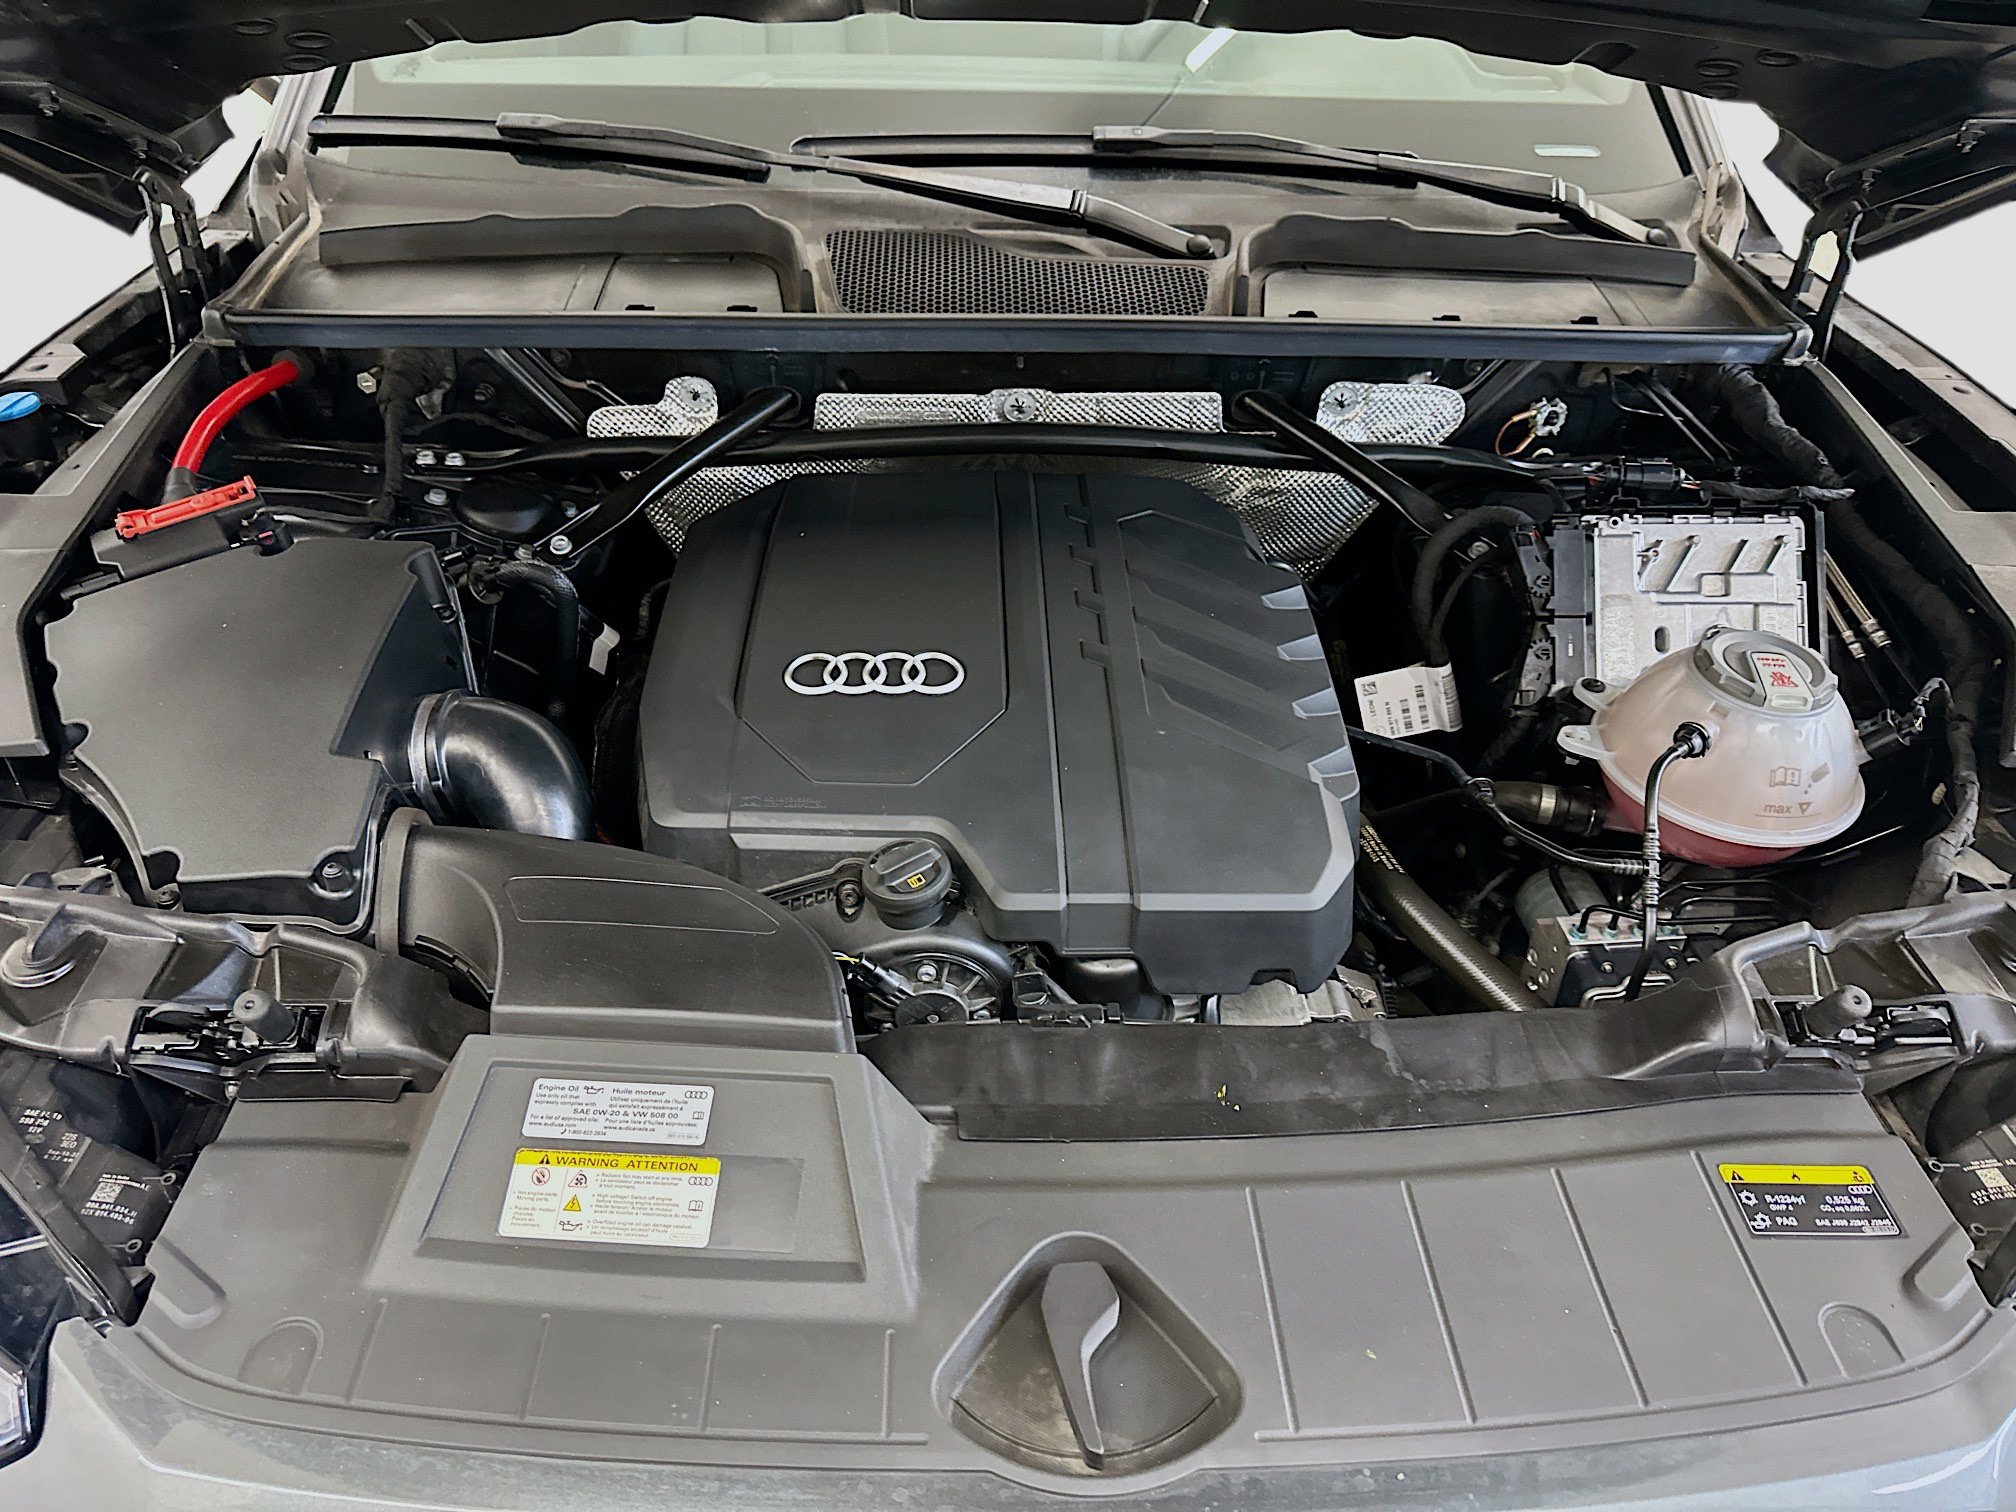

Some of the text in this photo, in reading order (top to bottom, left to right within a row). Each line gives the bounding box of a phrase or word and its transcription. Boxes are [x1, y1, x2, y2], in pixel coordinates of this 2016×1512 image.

[1763, 804, 1792, 814] max
[538, 1083, 566, 1093] Engine
[630, 1097, 663, 1105] uniquement
[592, 1109, 620, 1117] 0W-20
[556, 1156, 698, 1172] WARNING ATTENTION
[1764, 1194, 1806, 1205] R-1234yf
[1851, 1196, 1866, 1206] kg
[1776, 1216, 1799, 1226] PAG
[1815, 1218, 1831, 1226] SAE
